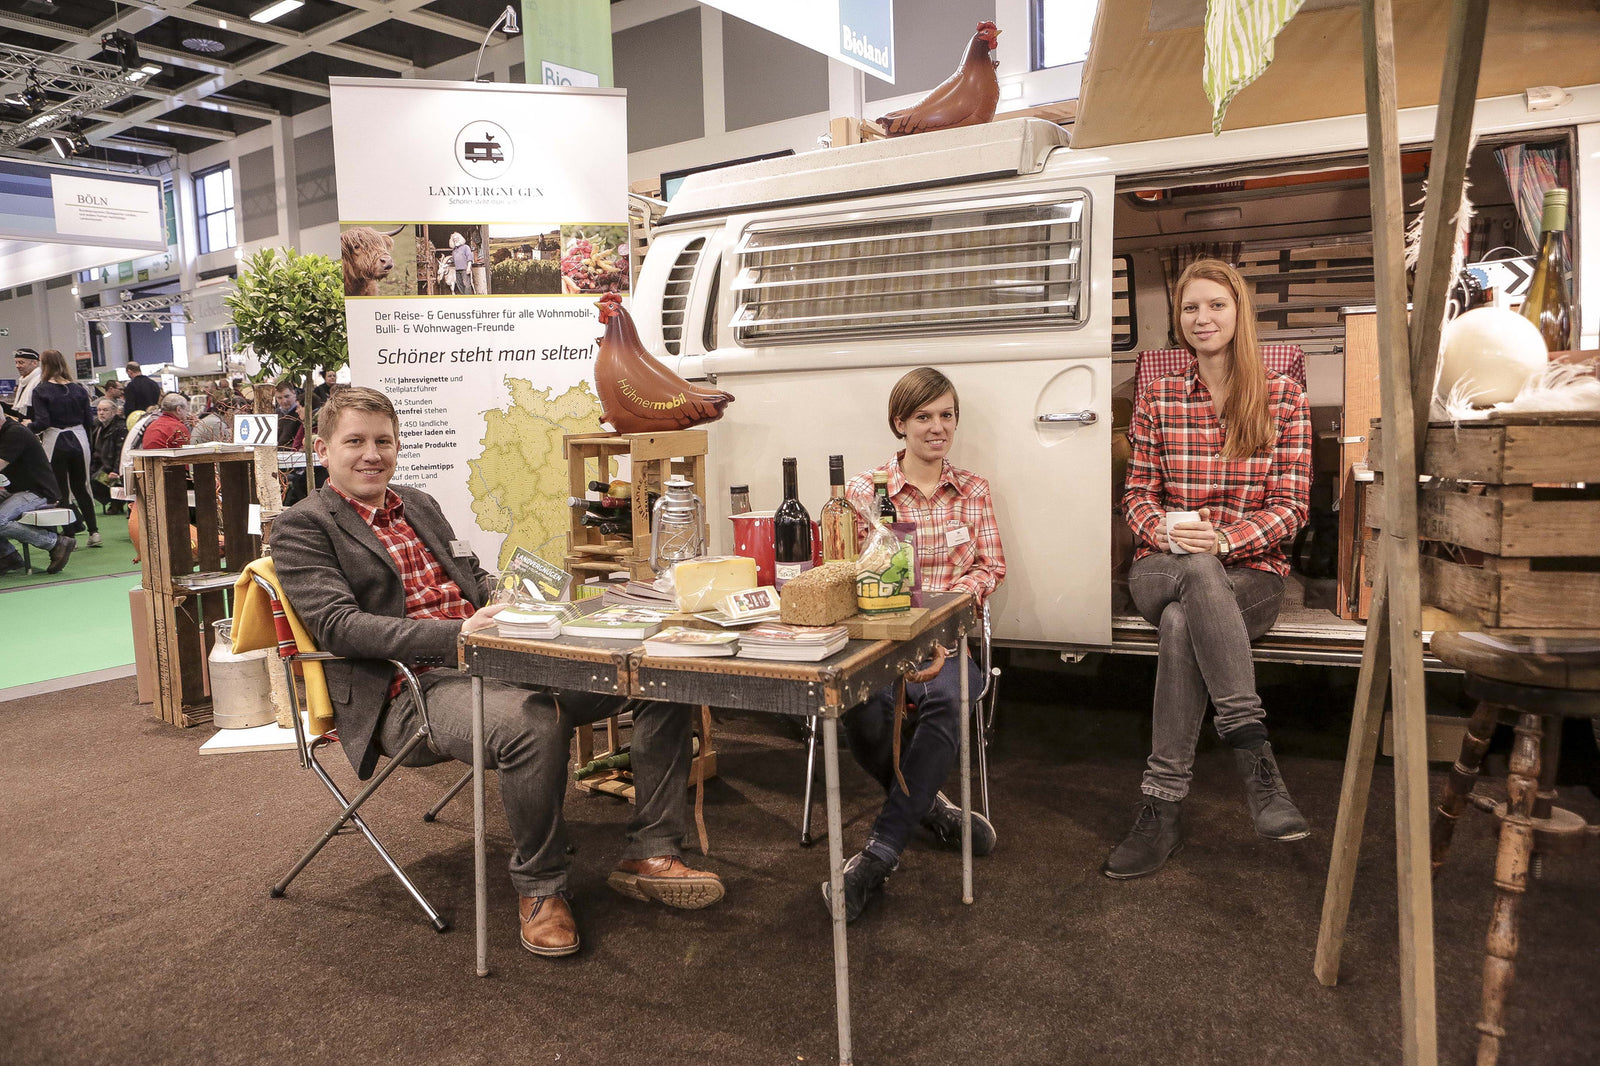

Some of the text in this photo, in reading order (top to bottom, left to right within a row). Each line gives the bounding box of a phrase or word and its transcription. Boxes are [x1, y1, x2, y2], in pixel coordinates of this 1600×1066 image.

[843, 24, 889, 68] Bioland
[77, 194, 108, 206] BÖLN
[374, 308, 596, 321] Der Reise- & Genussführer für alle Wohnmobil-,
[375, 322, 515, 335] Bulli- & Wohnwagen-Freunde
[377, 344, 594, 365] Schöner steht man selten!
[397, 375, 449, 385] Jahresvignette
[450, 375, 464, 383] und
[384, 385, 438, 394] Stellplatzführer
[617, 378, 687, 410] Hühnermobil
[404, 398, 433, 406] Stunden
[395, 407, 423, 415] stenfrei
[404, 420, 418, 428] 450
[400, 442, 423, 451] gionale
[397, 451, 421, 459] nießen
[410, 463, 454, 471] Geheimtipps
